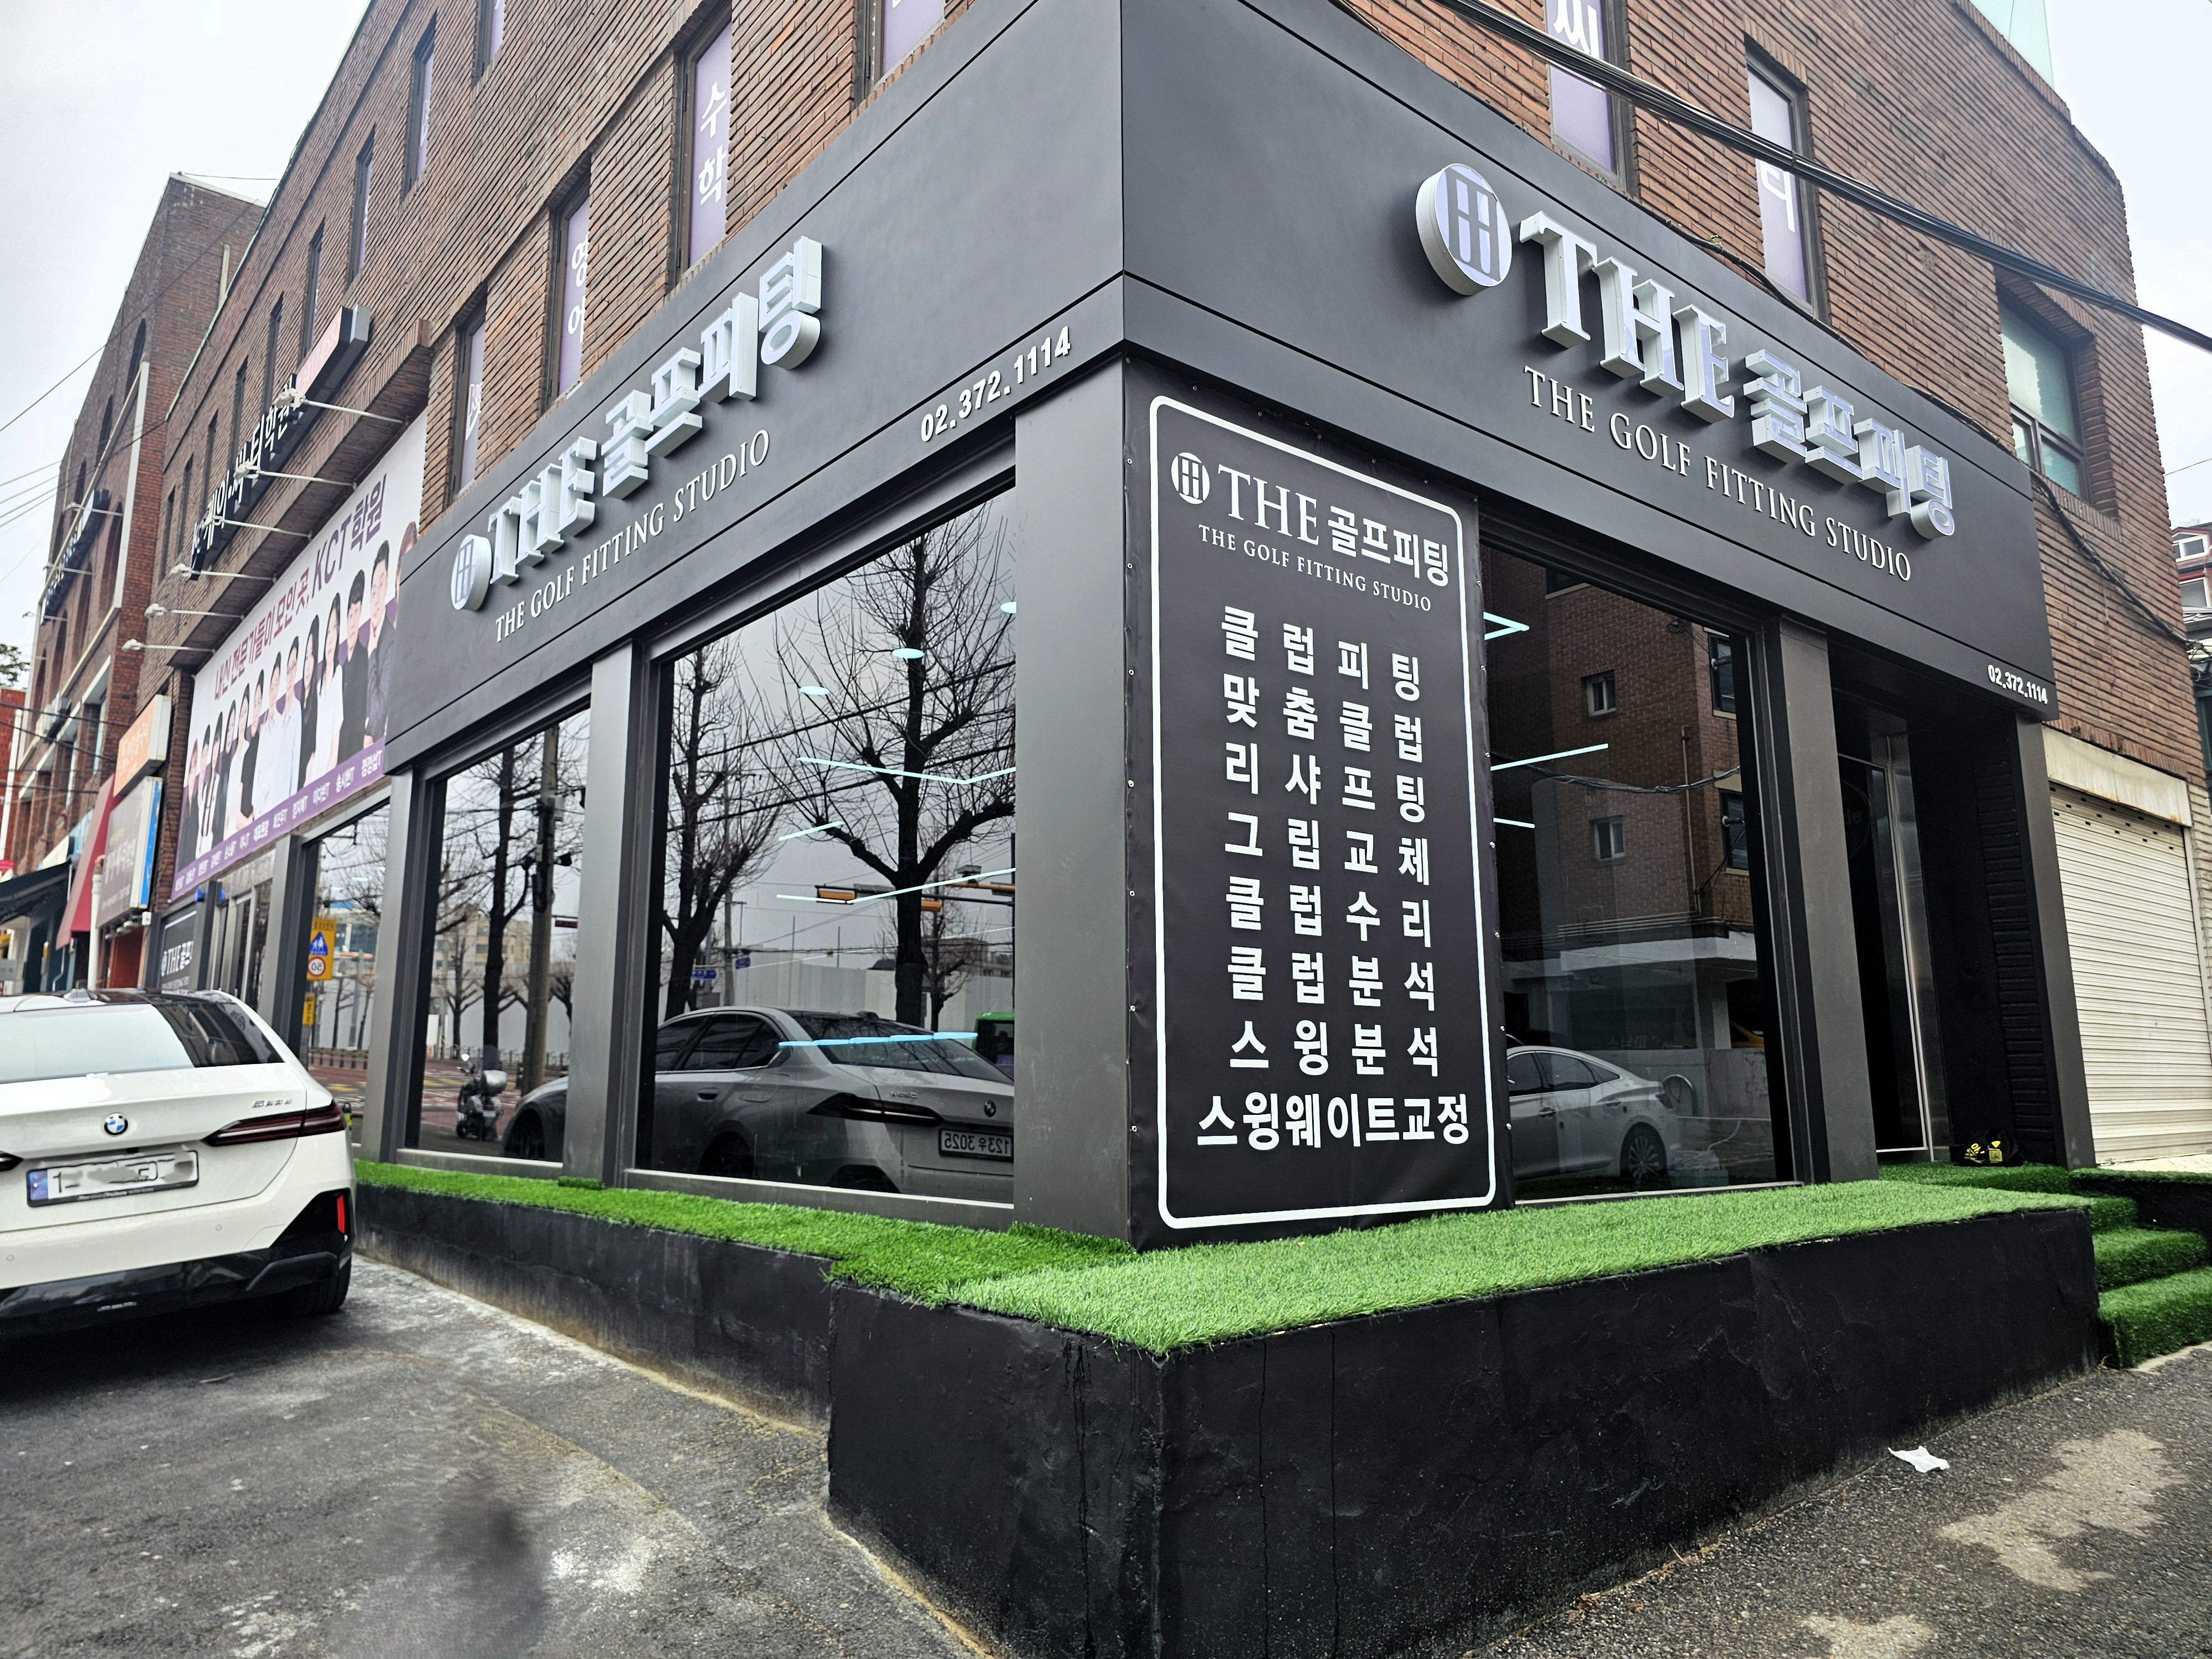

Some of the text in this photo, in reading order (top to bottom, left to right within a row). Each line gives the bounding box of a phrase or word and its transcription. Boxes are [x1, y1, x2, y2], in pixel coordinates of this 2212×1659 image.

[699, 81, 727, 205] 수학
[488, 236, 822, 585] THE 골프피팅
[921, 326, 1071, 442] 02.372.1114
[1520, 211, 1955, 540] THE 골프피팅
[496, 429, 770, 643] THE GOLF FITTING STUDIO
[1218, 463, 1449, 587] THE 골프피팅
[1524, 366, 1911, 582] THE GOLF FITTING STUDIO
[231, 605, 275, 686] 전문가들이
[273, 586, 296, 639] 모인
[311, 513, 353, 599] KCT
[351, 472, 388, 552] 학원
[1198, 523, 1432, 612] THE GOLF FITTING STUDIO
[1987, 664, 2048, 705] 02.372.1114
[1197, 1091, 1469, 1151] 스윙웨이트교정
